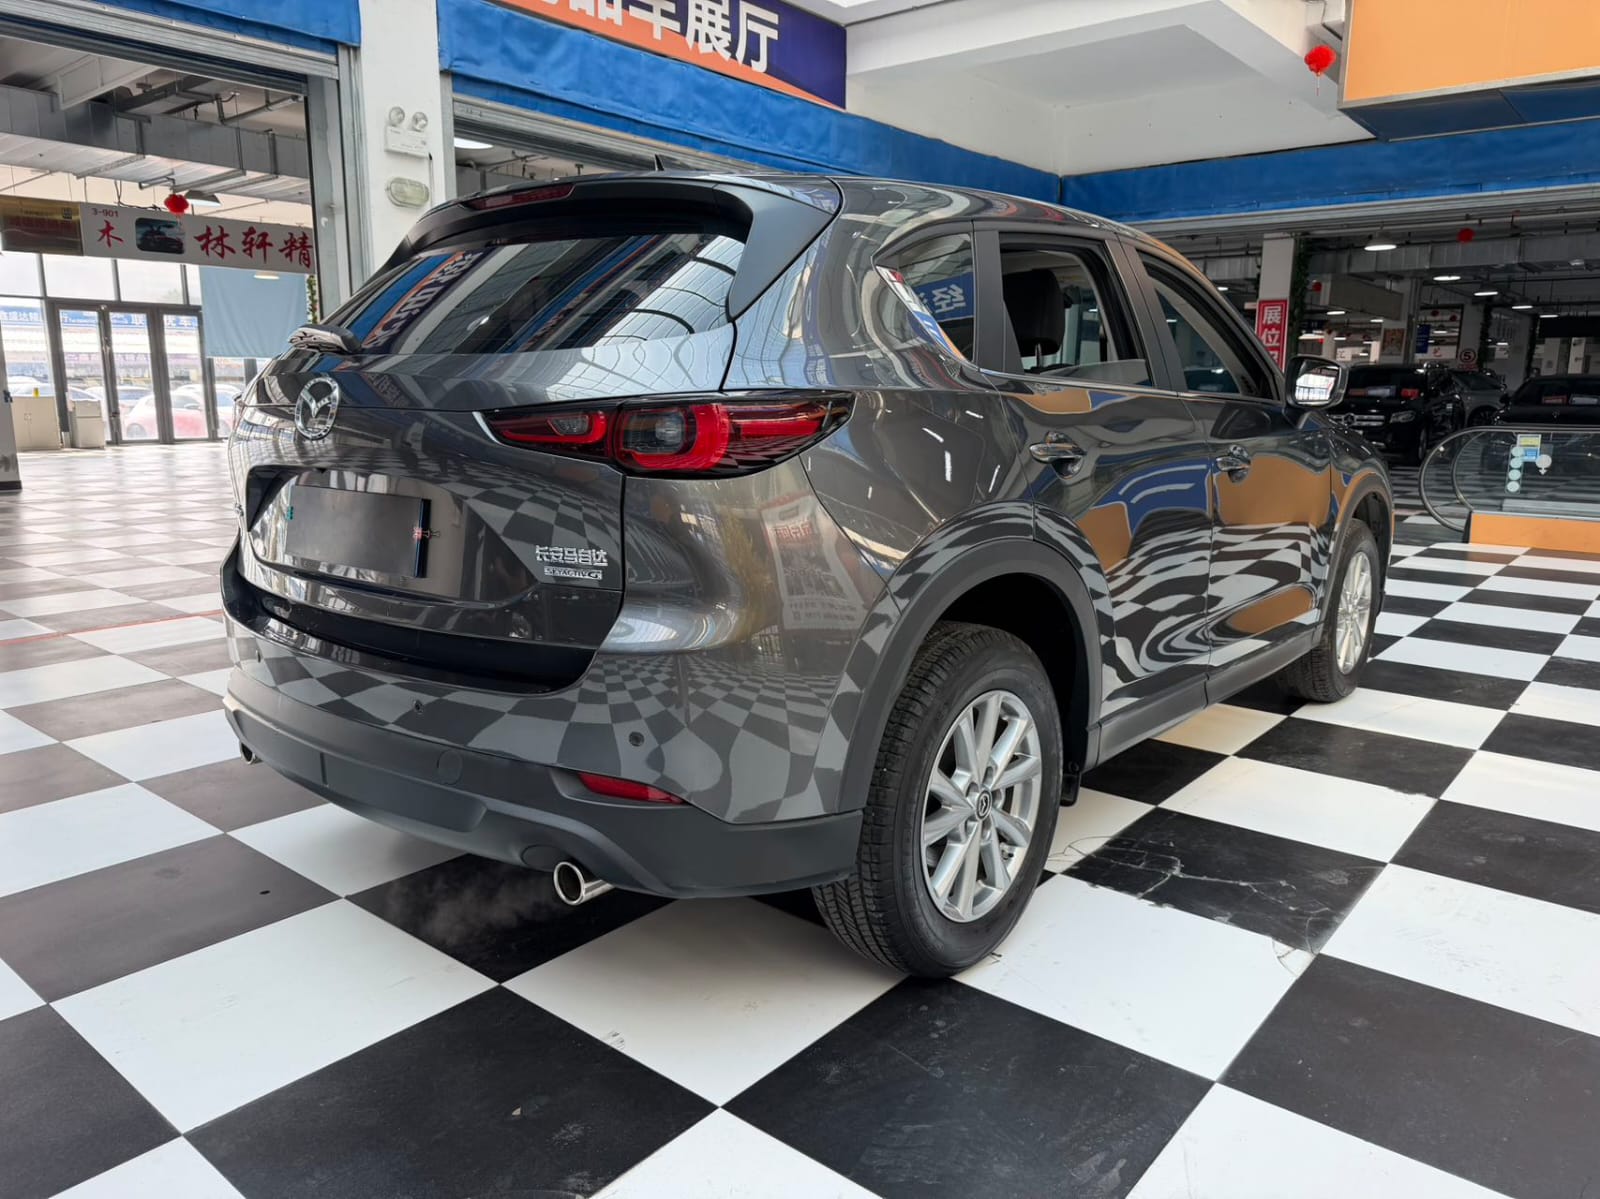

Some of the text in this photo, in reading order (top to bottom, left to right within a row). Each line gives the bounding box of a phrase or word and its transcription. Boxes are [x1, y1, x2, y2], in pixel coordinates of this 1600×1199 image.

[538, 0, 779, 73] 车展厅
[91, 207, 119, 218] 3-901
[97, 220, 314, 269] 木 林轩精
[535, 545, 608, 566] 长安马自达
